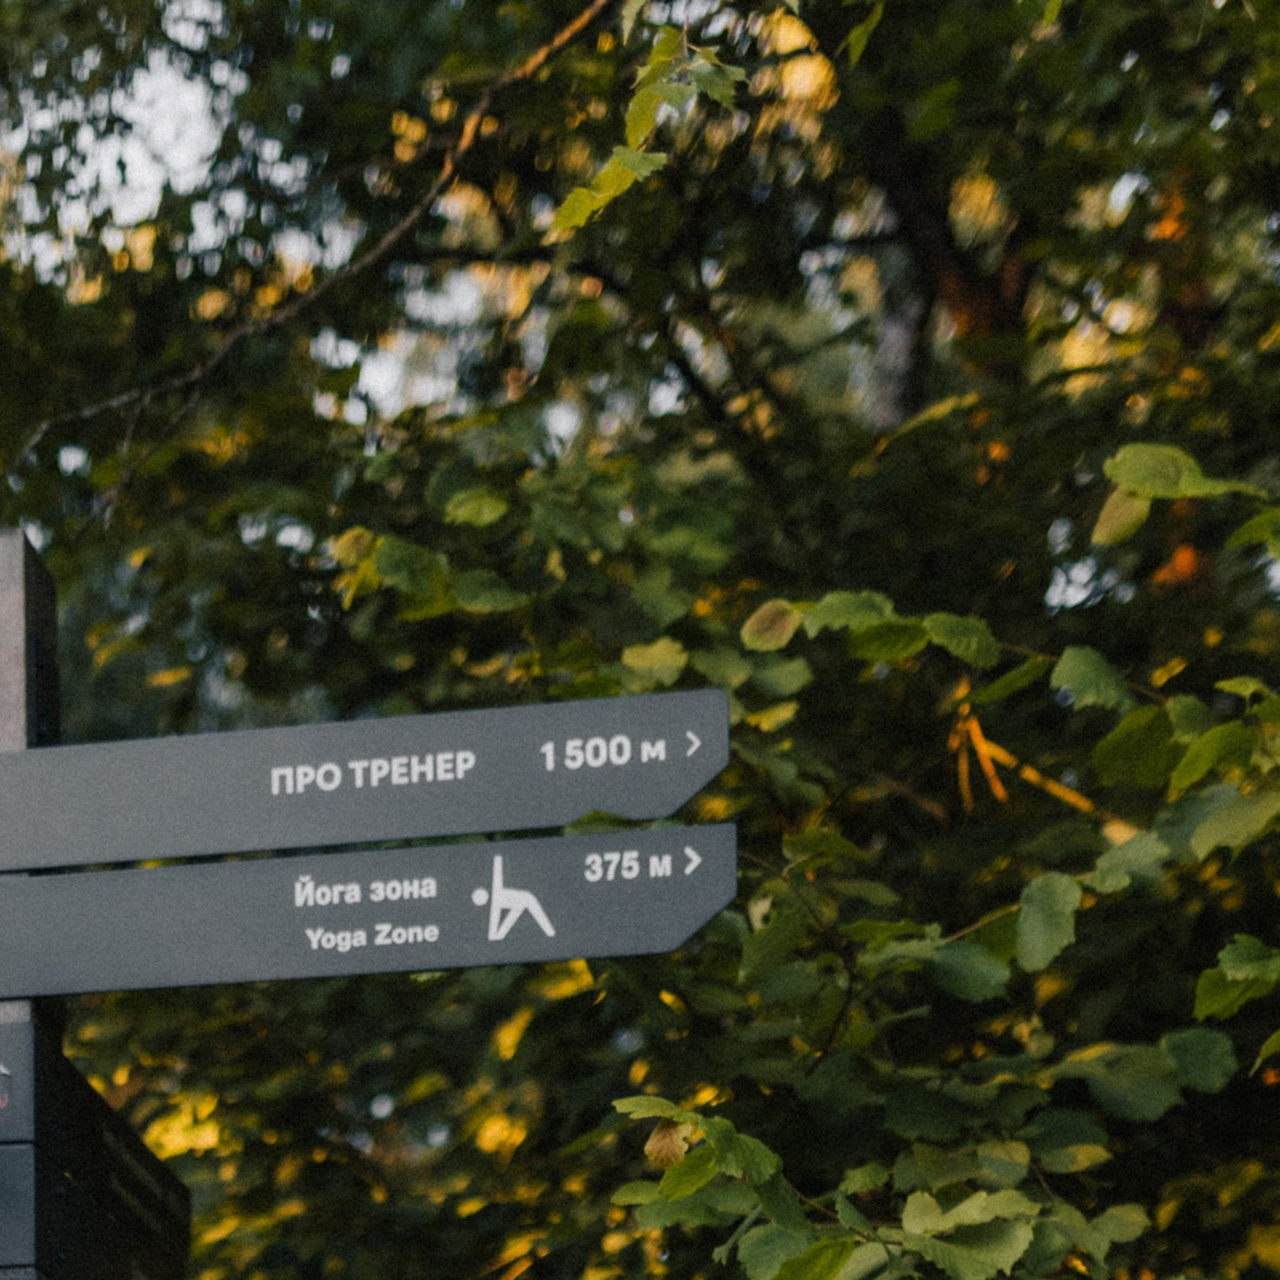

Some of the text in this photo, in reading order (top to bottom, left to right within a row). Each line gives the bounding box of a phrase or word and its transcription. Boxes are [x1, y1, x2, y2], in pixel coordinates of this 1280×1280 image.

[640, 739, 667, 764] м
[270, 749, 477, 796] ПРО ТРЕНЕР
[584, 850, 673, 883] 375 м
[293, 873, 438, 908] Йога зона
[304, 921, 440, 954] Yoga Zone
